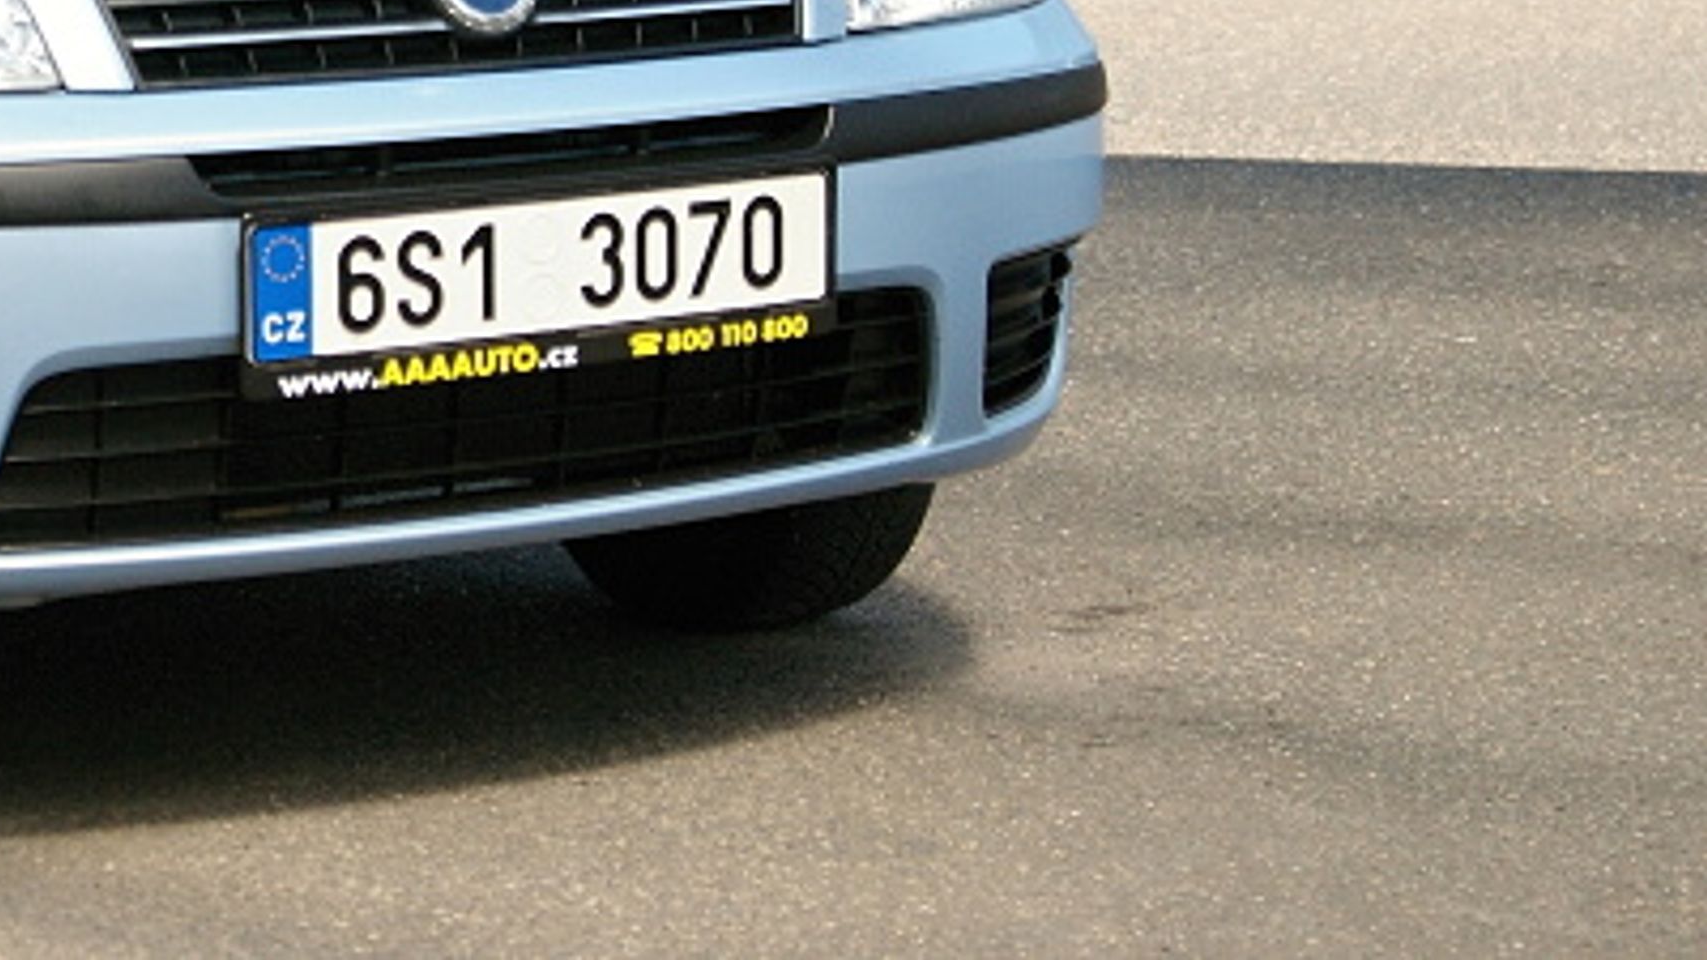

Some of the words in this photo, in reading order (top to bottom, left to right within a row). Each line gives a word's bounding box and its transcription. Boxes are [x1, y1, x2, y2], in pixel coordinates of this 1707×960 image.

[337, 223, 495, 334] 6S1
[580, 195, 783, 307] 3070
[261, 311, 306, 343] CZ
[666, 326, 714, 354] 800
[761, 313, 809, 342] 800
[278, 343, 579, 398] www.AAAAUTO.cz
